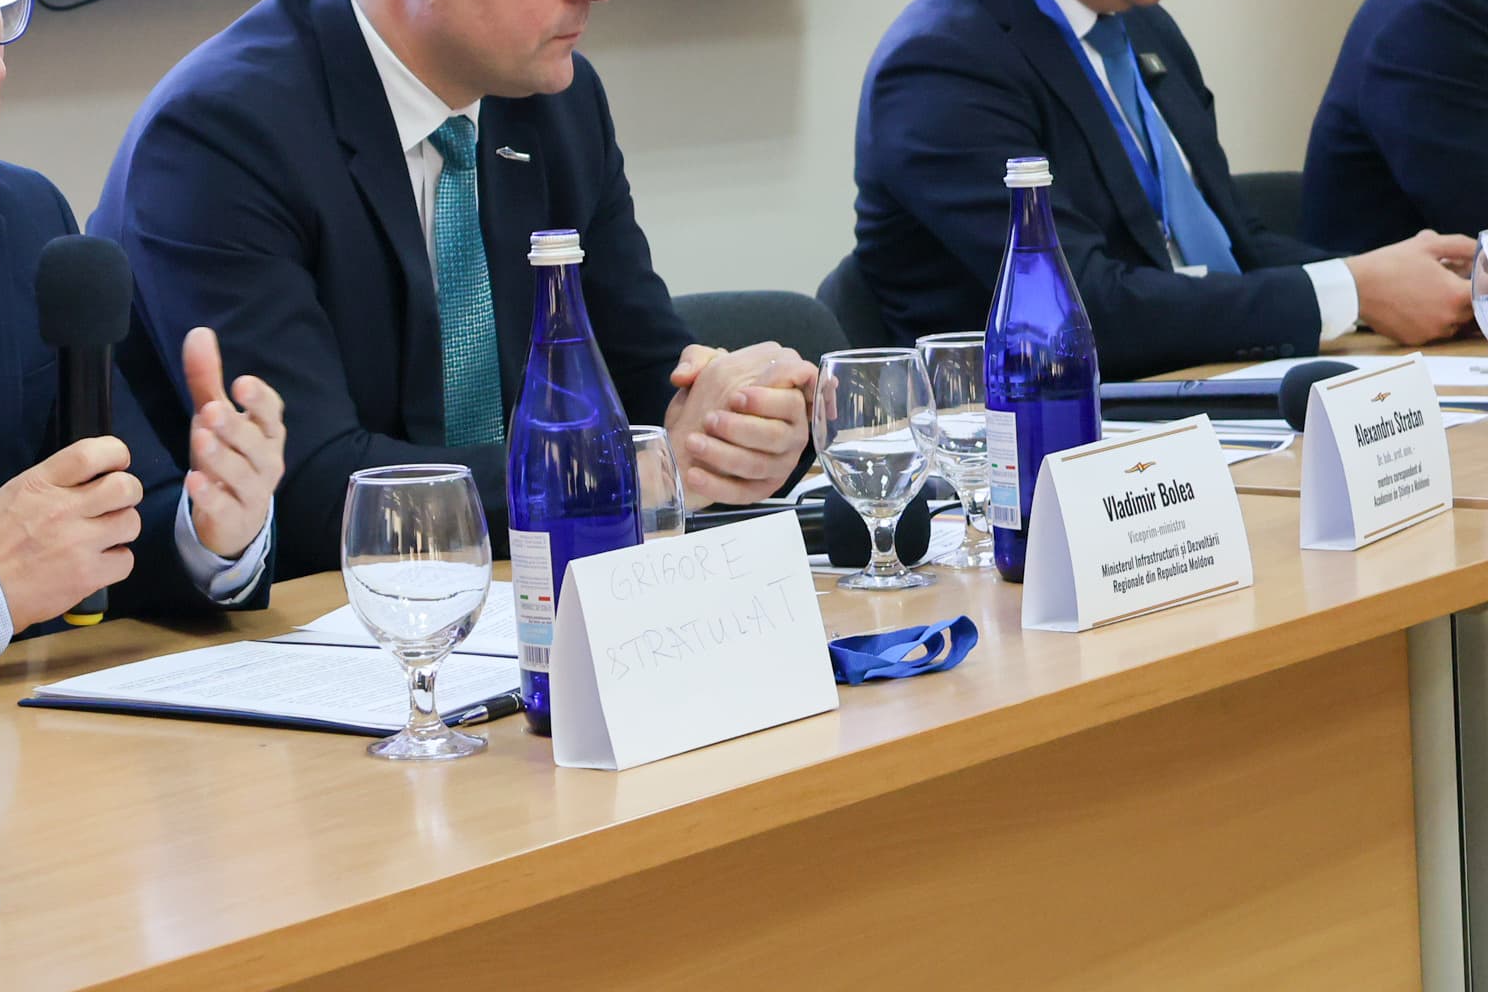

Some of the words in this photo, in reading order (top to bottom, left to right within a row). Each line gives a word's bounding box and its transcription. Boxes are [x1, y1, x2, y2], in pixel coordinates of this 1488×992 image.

[1355, 416, 1396, 448] Alexandru
[1394, 408, 1424, 433] Stratan
[1103, 488, 1156, 522] Vladimir
[1158, 479, 1195, 509] Bolea
[1102, 557, 1134, 578] Ministerul
[1135, 544, 1180, 568] Infrastructurii
[1113, 573, 1144, 593] Regionale
[1146, 570, 1156, 584] din
[1157, 561, 1188, 582] Republica
[1189, 555, 1214, 571] Moldova
[607, 576, 795, 680] STRATULAT
